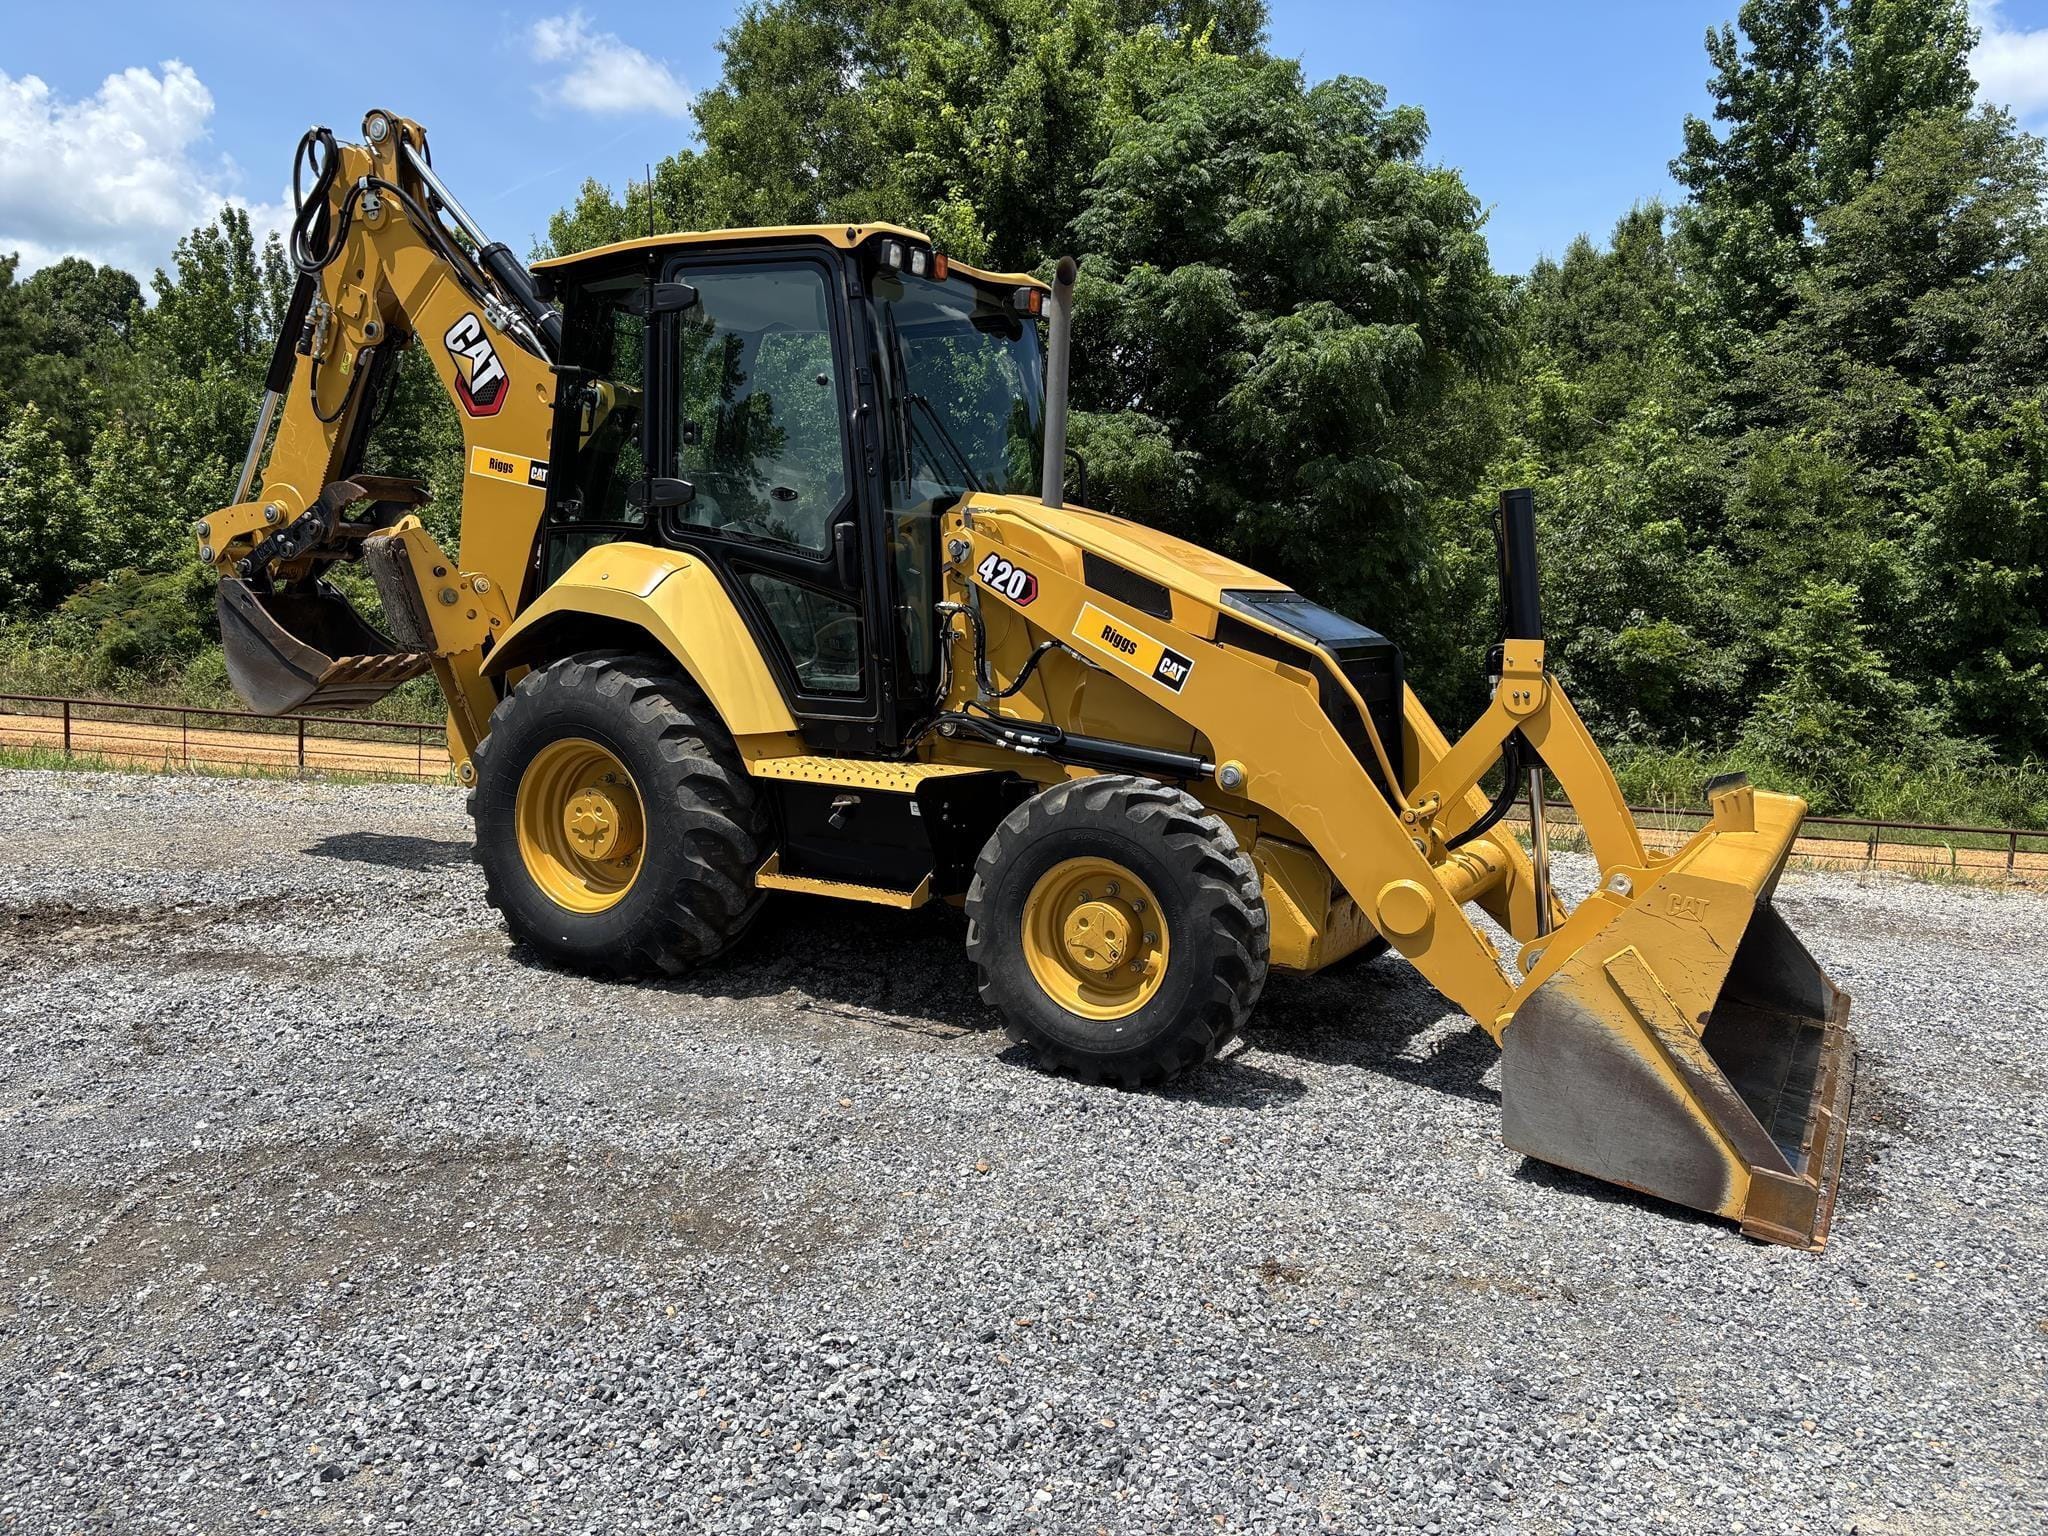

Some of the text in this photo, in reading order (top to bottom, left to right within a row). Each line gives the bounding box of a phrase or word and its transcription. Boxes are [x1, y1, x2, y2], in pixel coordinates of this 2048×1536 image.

[446, 314, 505, 395] CAT
[488, 457, 548, 482] Riggs CAT
[979, 554, 1027, 600] 420
[1100, 624, 1187, 682] Riggs CAT
[1666, 893, 1710, 922] CAT
